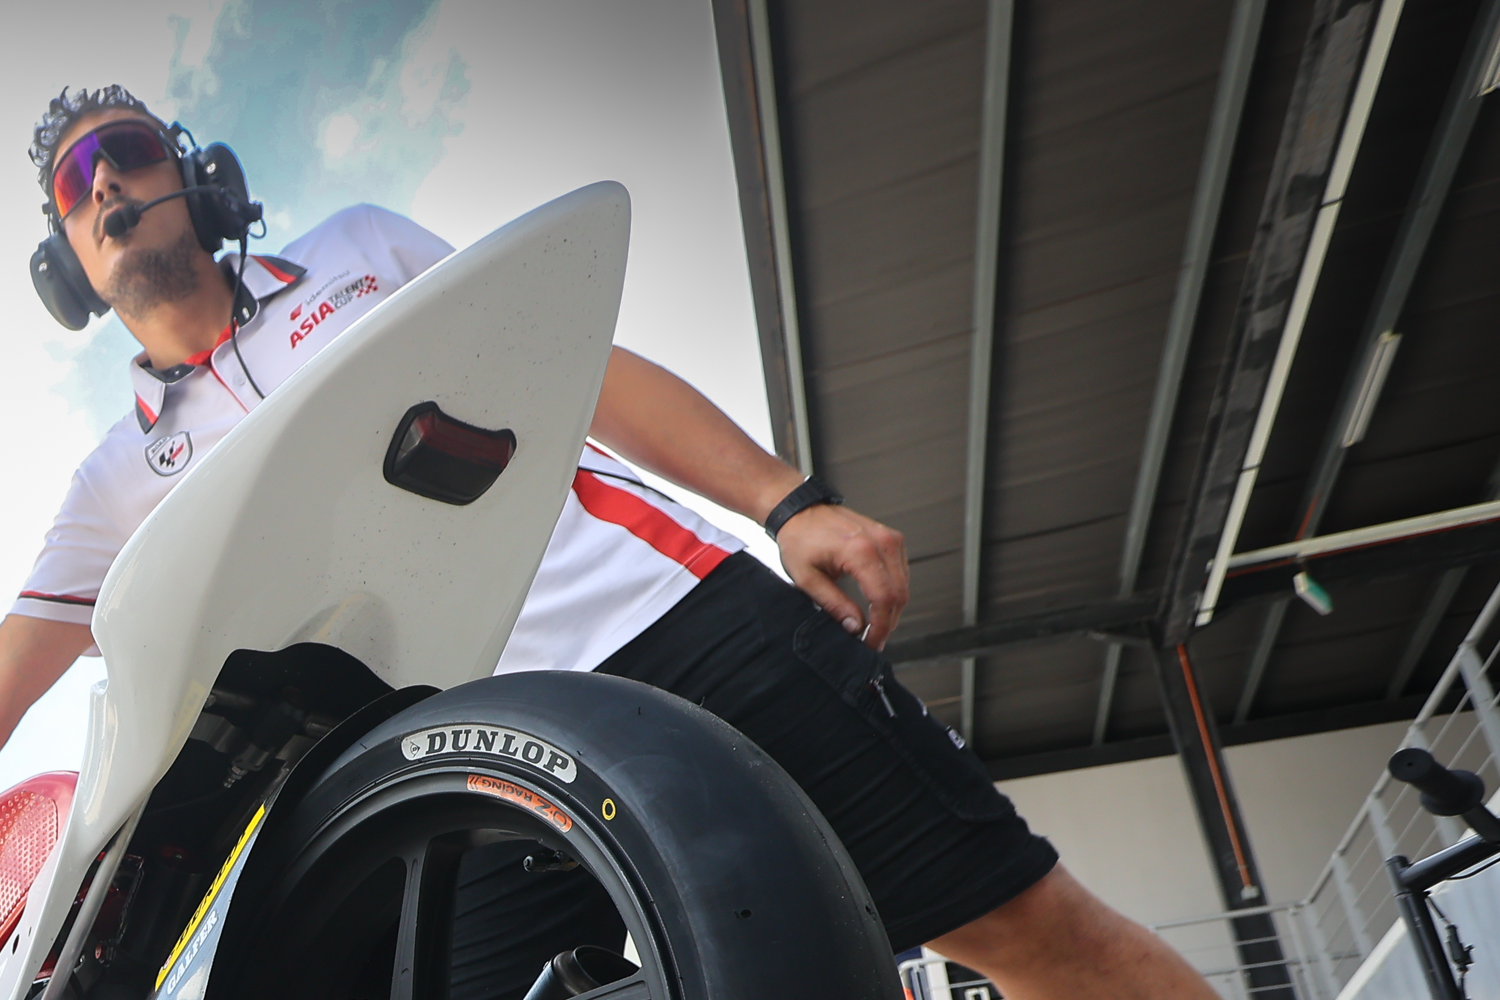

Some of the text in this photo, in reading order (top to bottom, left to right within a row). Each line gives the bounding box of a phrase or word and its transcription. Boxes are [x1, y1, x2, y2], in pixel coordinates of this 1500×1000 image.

[327, 279, 364, 303] TALENT
[334, 294, 354, 310] CUP
[290, 301, 335, 349] ASIA
[425, 728, 569, 774] DUNLOP
[482, 779, 533, 802] RACING
[167, 910, 219, 995] GALFER
